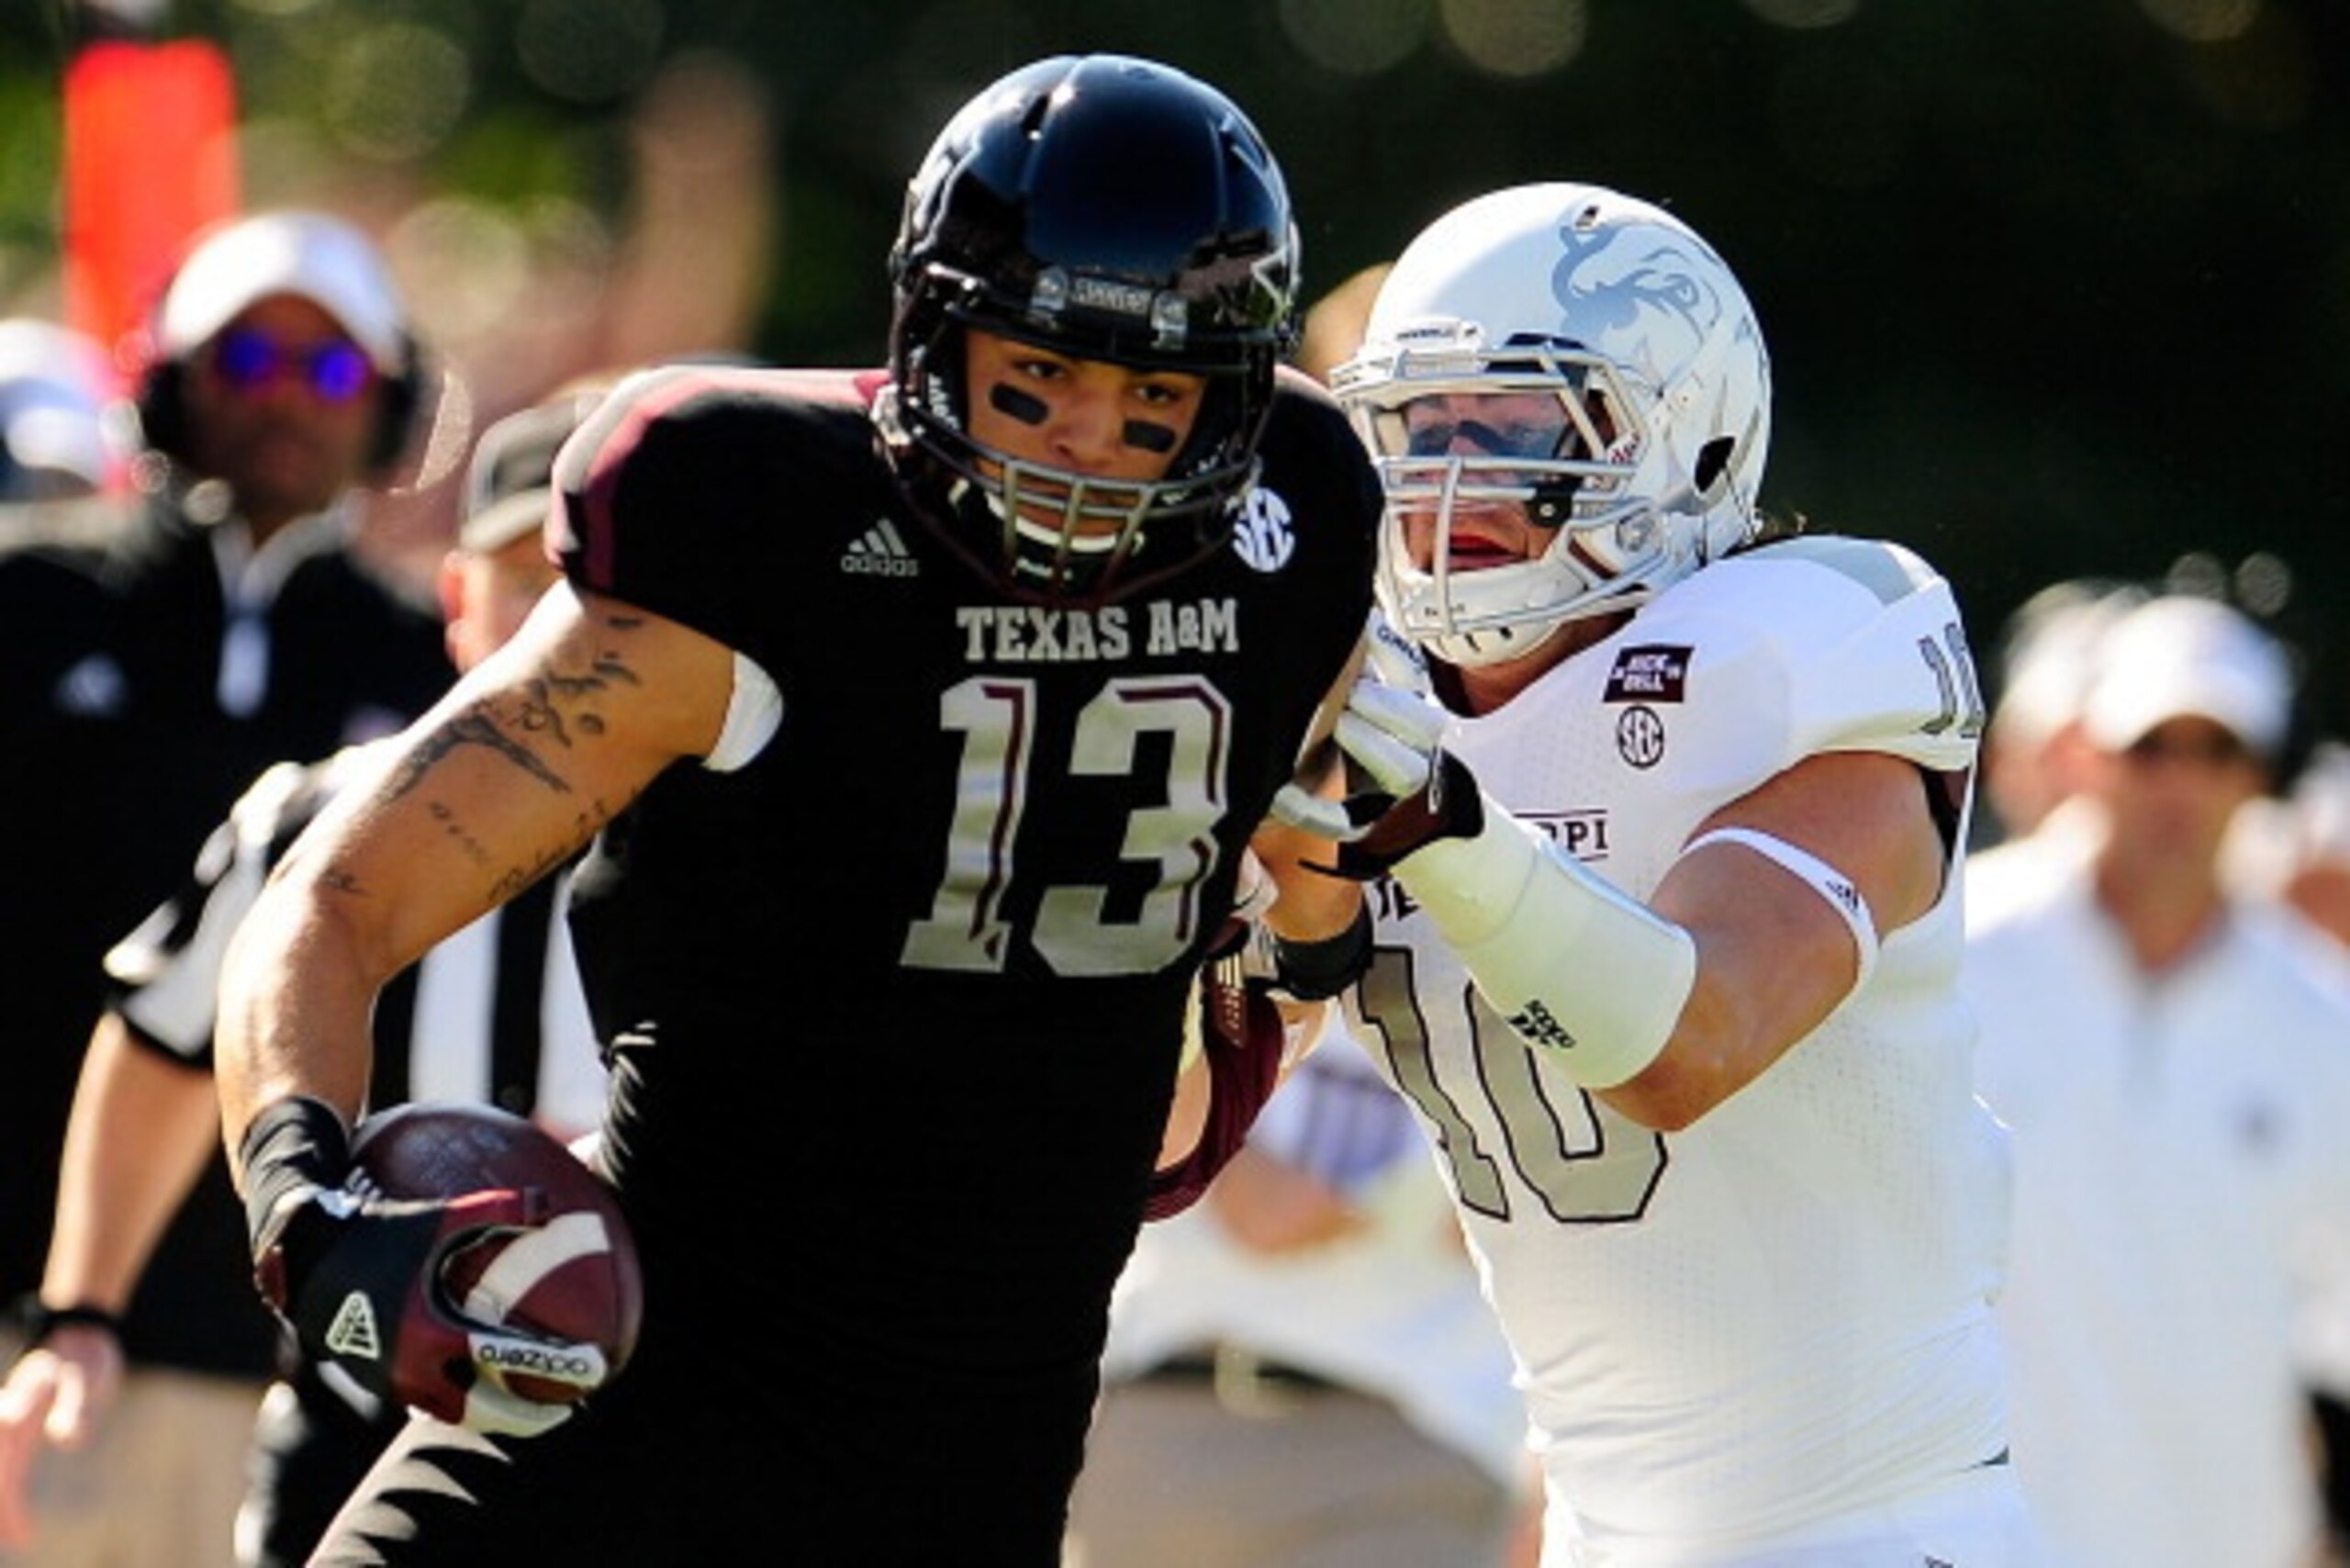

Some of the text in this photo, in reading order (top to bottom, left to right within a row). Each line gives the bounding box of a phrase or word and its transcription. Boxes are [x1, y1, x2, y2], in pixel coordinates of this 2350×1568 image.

[840, 554, 918, 577] adidas
[1233, 487, 1295, 572] SEC
[957, 598, 1239, 661] TEXAS A&M
[1618, 706, 1663, 768] SEC
[899, 673, 1232, 978] 13
[1357, 945, 1669, 1224] 10
